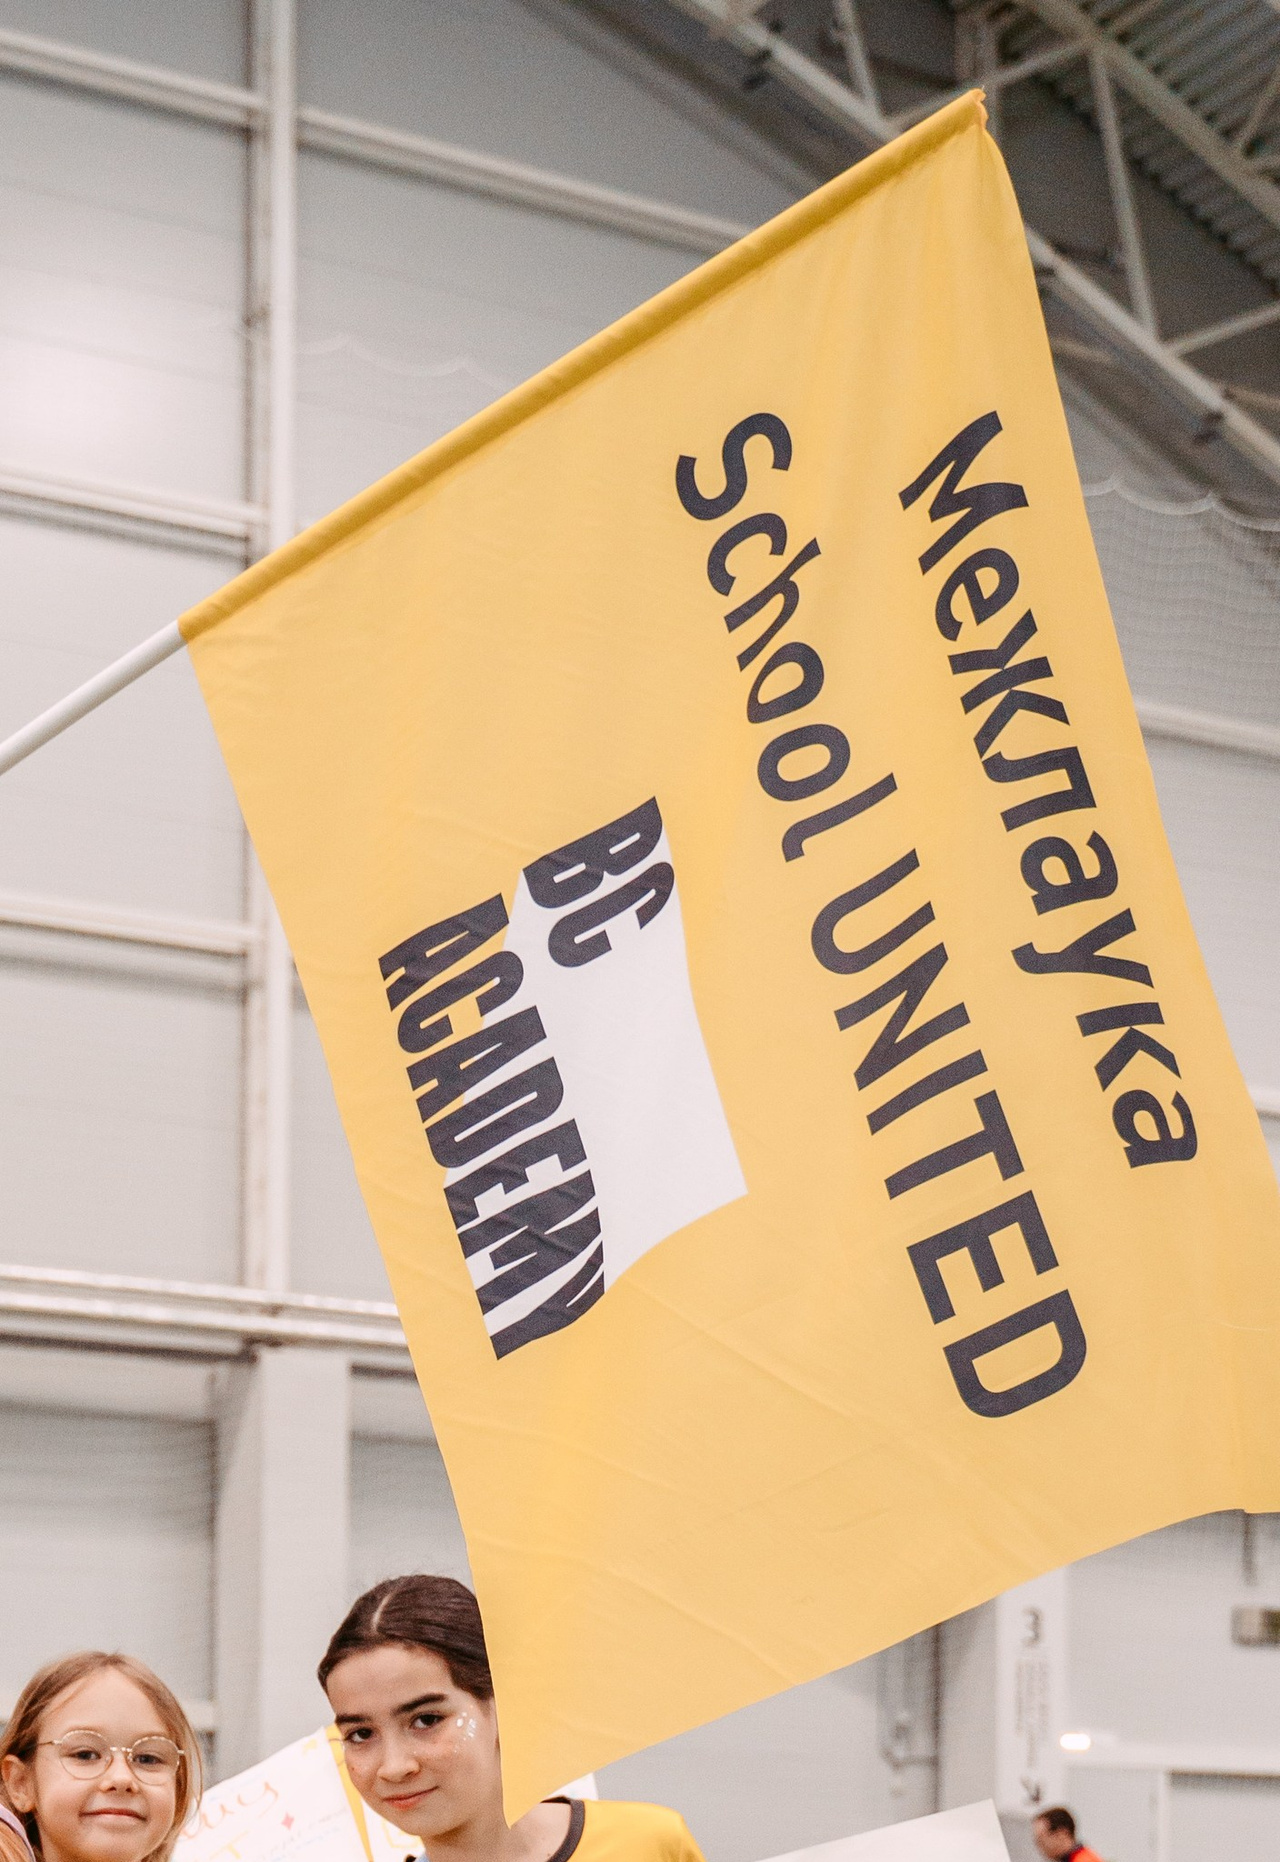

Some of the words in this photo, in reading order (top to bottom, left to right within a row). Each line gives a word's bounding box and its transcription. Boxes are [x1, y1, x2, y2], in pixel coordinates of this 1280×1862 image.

[523, 797, 675, 967] BC
[676, 413, 898, 862] School
[812, 849, 1087, 1417] UNITED
[899, 411, 1198, 1168] Межлаука
[379, 893, 604, 1360] ACADEMY
